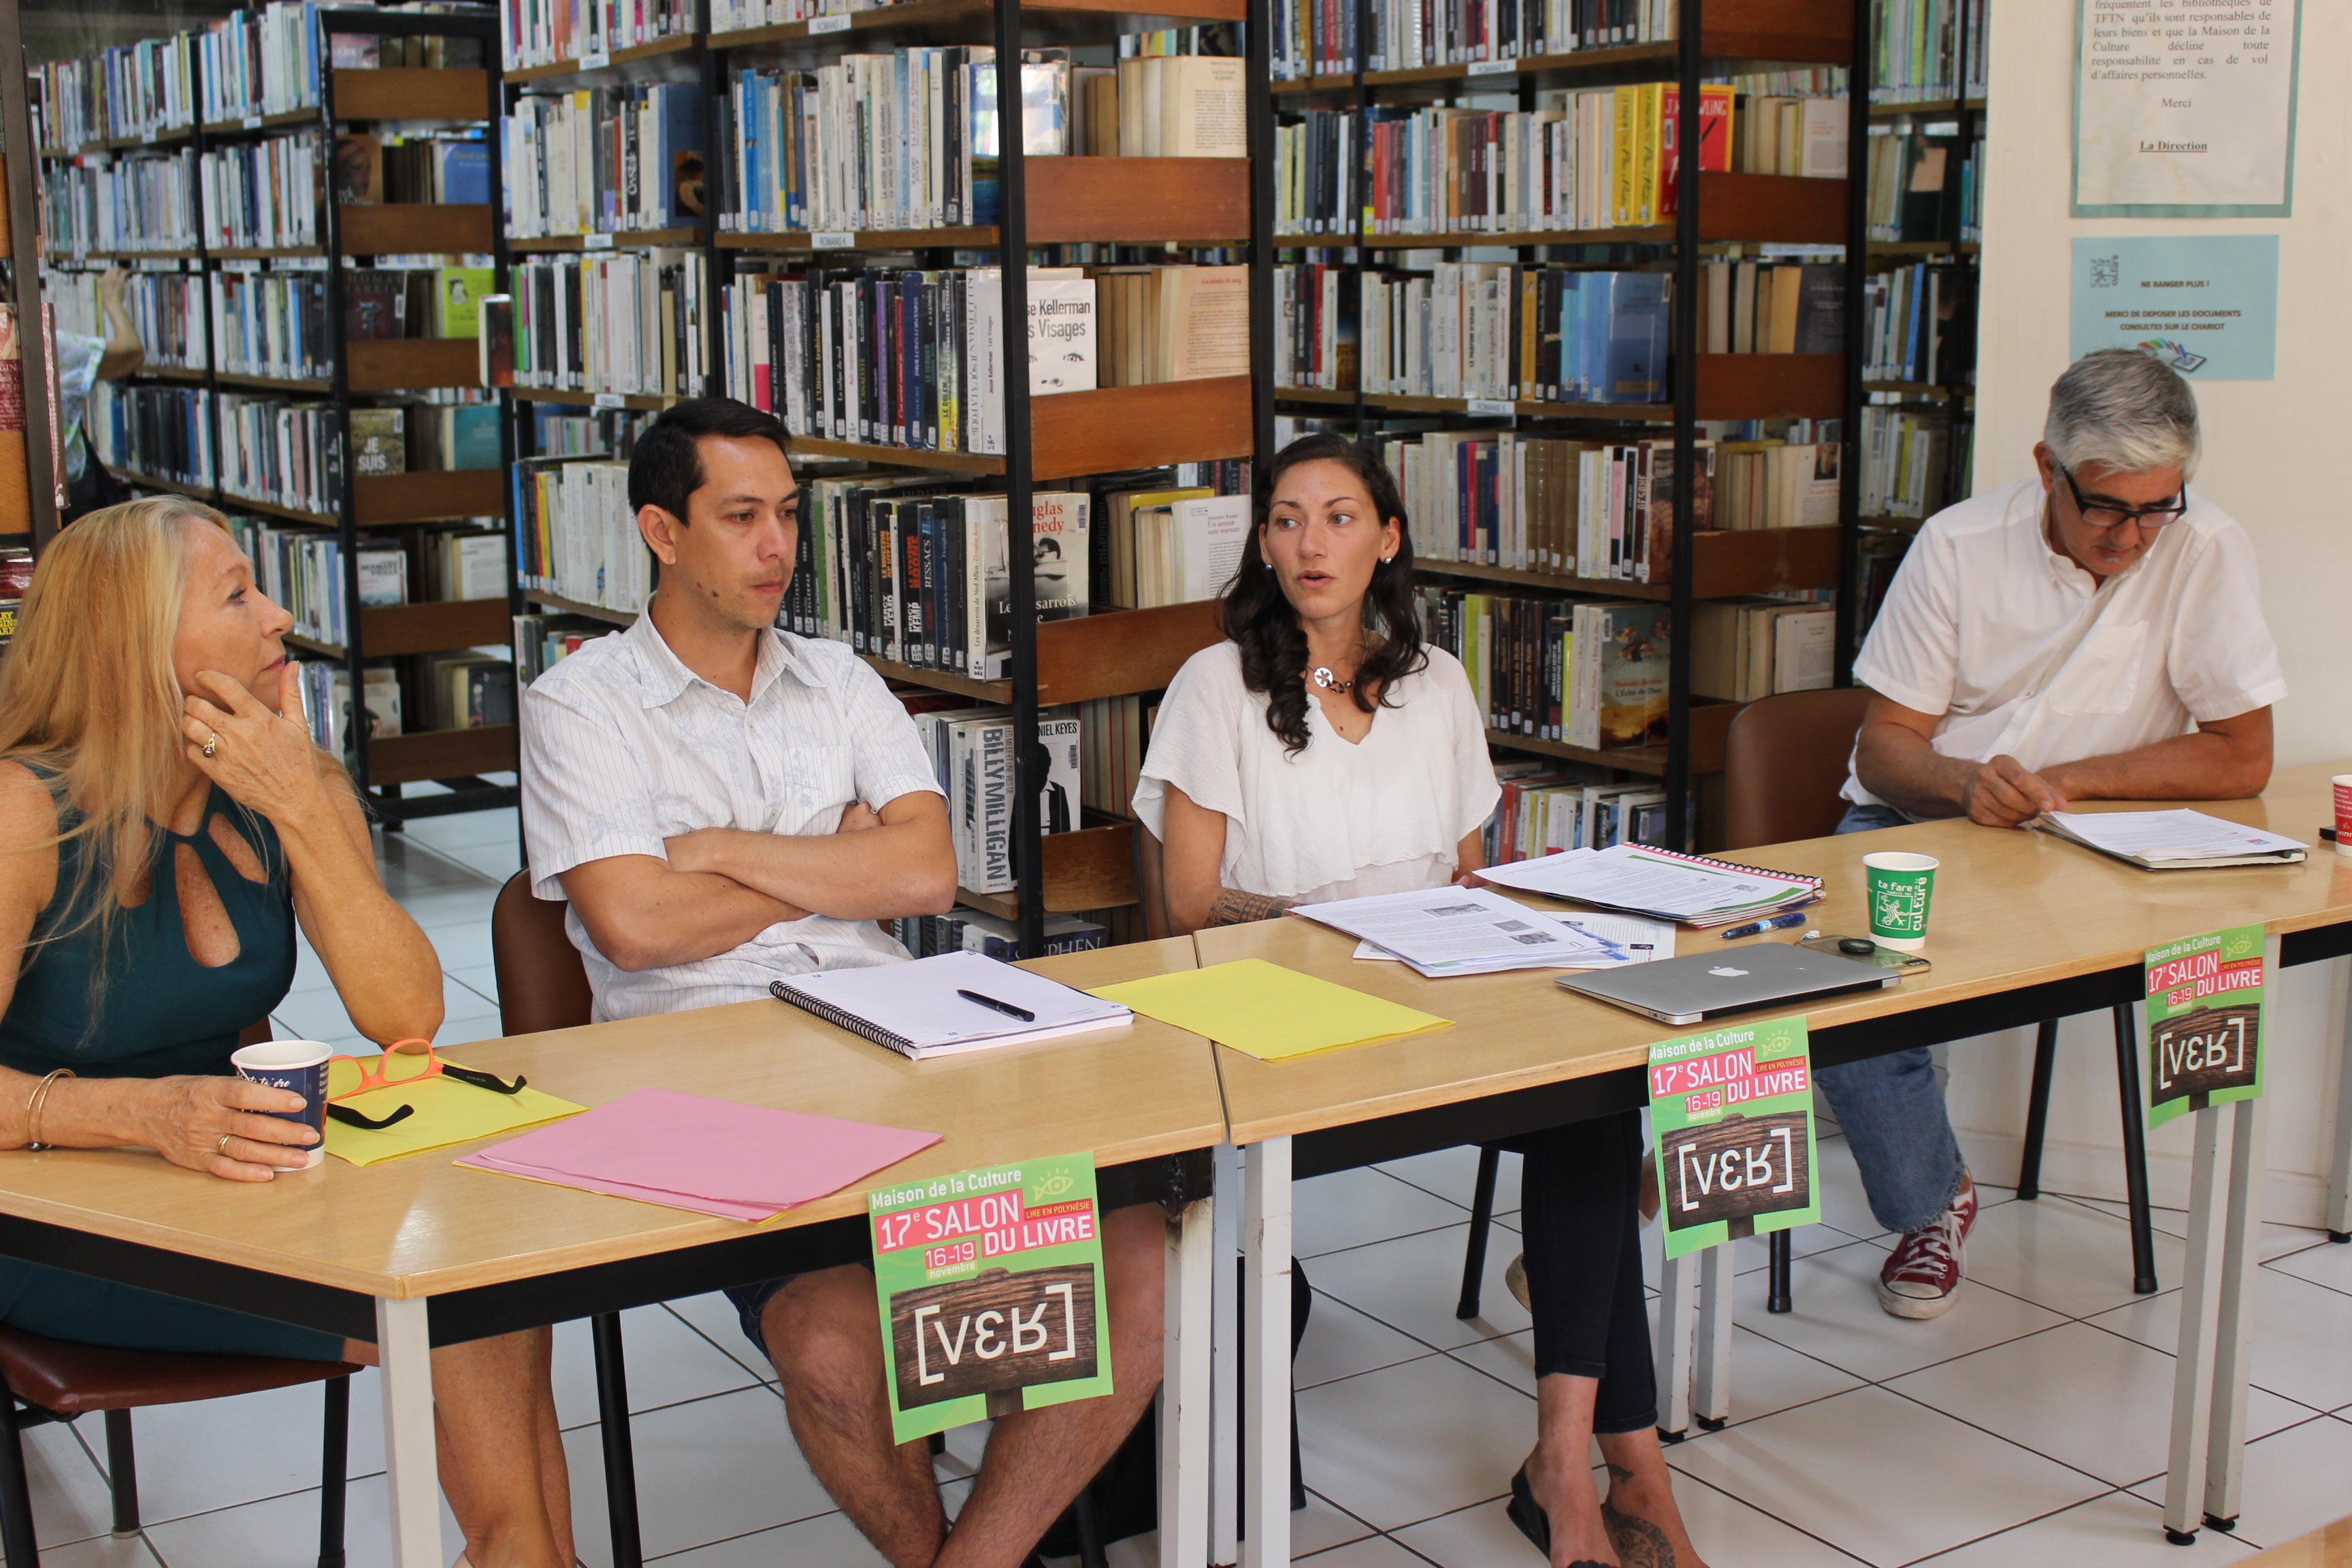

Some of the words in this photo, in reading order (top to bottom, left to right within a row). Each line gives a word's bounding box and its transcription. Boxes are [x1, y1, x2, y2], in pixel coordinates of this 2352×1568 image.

[2095, 14, 2125, 24] TFTN
[2165, 14, 2185, 22] sont
[2189, 12, 2255, 24] responsables
[2259, 11, 2271, 20] de
[2094, 28, 2117, 37] leurs
[2122, 27, 2148, 37] biens
[2152, 29, 2161, 37] et
[2165, 29, 2184, 39] que
[2189, 27, 2198, 36] la
[2202, 26, 2240, 36] Maison
[2244, 25, 2257, 35] de
[2261, 24, 2270, 35] la
[2092, 42, 2130, 52] Culture
[2168, 40, 2204, 50] décline
[2243, 41, 2269, 50] toute
[2092, 56, 2161, 67] responsabilité
[2198, 56, 2214, 65] cas
[2226, 54, 2239, 64] de
[2252, 54, 2268, 64] vol
[2091, 70, 2138, 80] d'affaires
[2141, 69, 2207, 82] personnelles.
[2161, 98, 2192, 108] Merci
[2140, 141, 2155, 151] La
[2157, 140, 2208, 152] Direction
[1039, 299, 1090, 316] Kellerman
[1039, 319, 1086, 342] Visages
[364, 436, 379, 453] JE
[357, 453, 387, 471] SUIS
[1032, 501, 1063, 521] uglas
[924, 539, 932, 588] RESSACS
[973, 596, 979, 605] de
[1036, 595, 1077, 610] sarrois
[912, 602, 921, 633] KEMP
[1038, 724, 1054, 737] NIEL
[1056, 722, 1077, 736] KEYES
[983, 728, 1005, 779] BILLY
[985, 782, 1007, 881] MILLIGAN
[1878, 879, 1888, 889] te
[1891, 882, 1912, 892] fare
[1912, 877, 1927, 932] culture
[2146, 948, 2170, 964] Maison
[2172, 945, 2181, 955] de
[2183, 941, 2191, 952] la
[2192, 935, 2221, 950] Culture
[2149, 965, 2167, 993] 17e
[2168, 953, 2218, 985] SALON
[2197, 977, 2215, 997] DU
[2218, 969, 2261, 992] LIVRE
[2167, 987, 2192, 1006] 16-19
[1648, 1043, 1686, 1061] Maison
[1689, 1039, 1702, 1053] de
[1704, 1036, 1715, 1049] la
[1717, 1030, 1754, 1047] Culture
[1654, 1064, 1684, 1095] 17e
[1686, 1051, 1752, 1089] SALON
[1757, 1063, 1768, 1073] LIRE
[1776, 1058, 1805, 1069] POLYNÉSIE
[1727, 1079, 1750, 1103] DU
[1755, 1069, 1806, 1097] LIVRE
[1686, 1091, 1722, 1112] 16-19
[1688, 1107, 1721, 1121] novembre
[872, 1186, 925, 1209] Maison
[928, 1181, 948, 1199] de
[951, 1177, 965, 1194] la
[968, 1169, 1022, 1191] Culture
[1026, 1208, 1041, 1220] LIRE
[1043, 1207, 1053, 1216] EN
[1054, 1201, 1091, 1215] POLYNÉSIE
[881, 1210, 921, 1250] 17e
[926, 1193, 1020, 1239] SALON
[985, 1228, 1017, 1256] DU
[1024, 1215, 1093, 1248] LIVRE
[925, 1242, 975, 1269] 16-19
[930, 1260, 975, 1279] novembre
